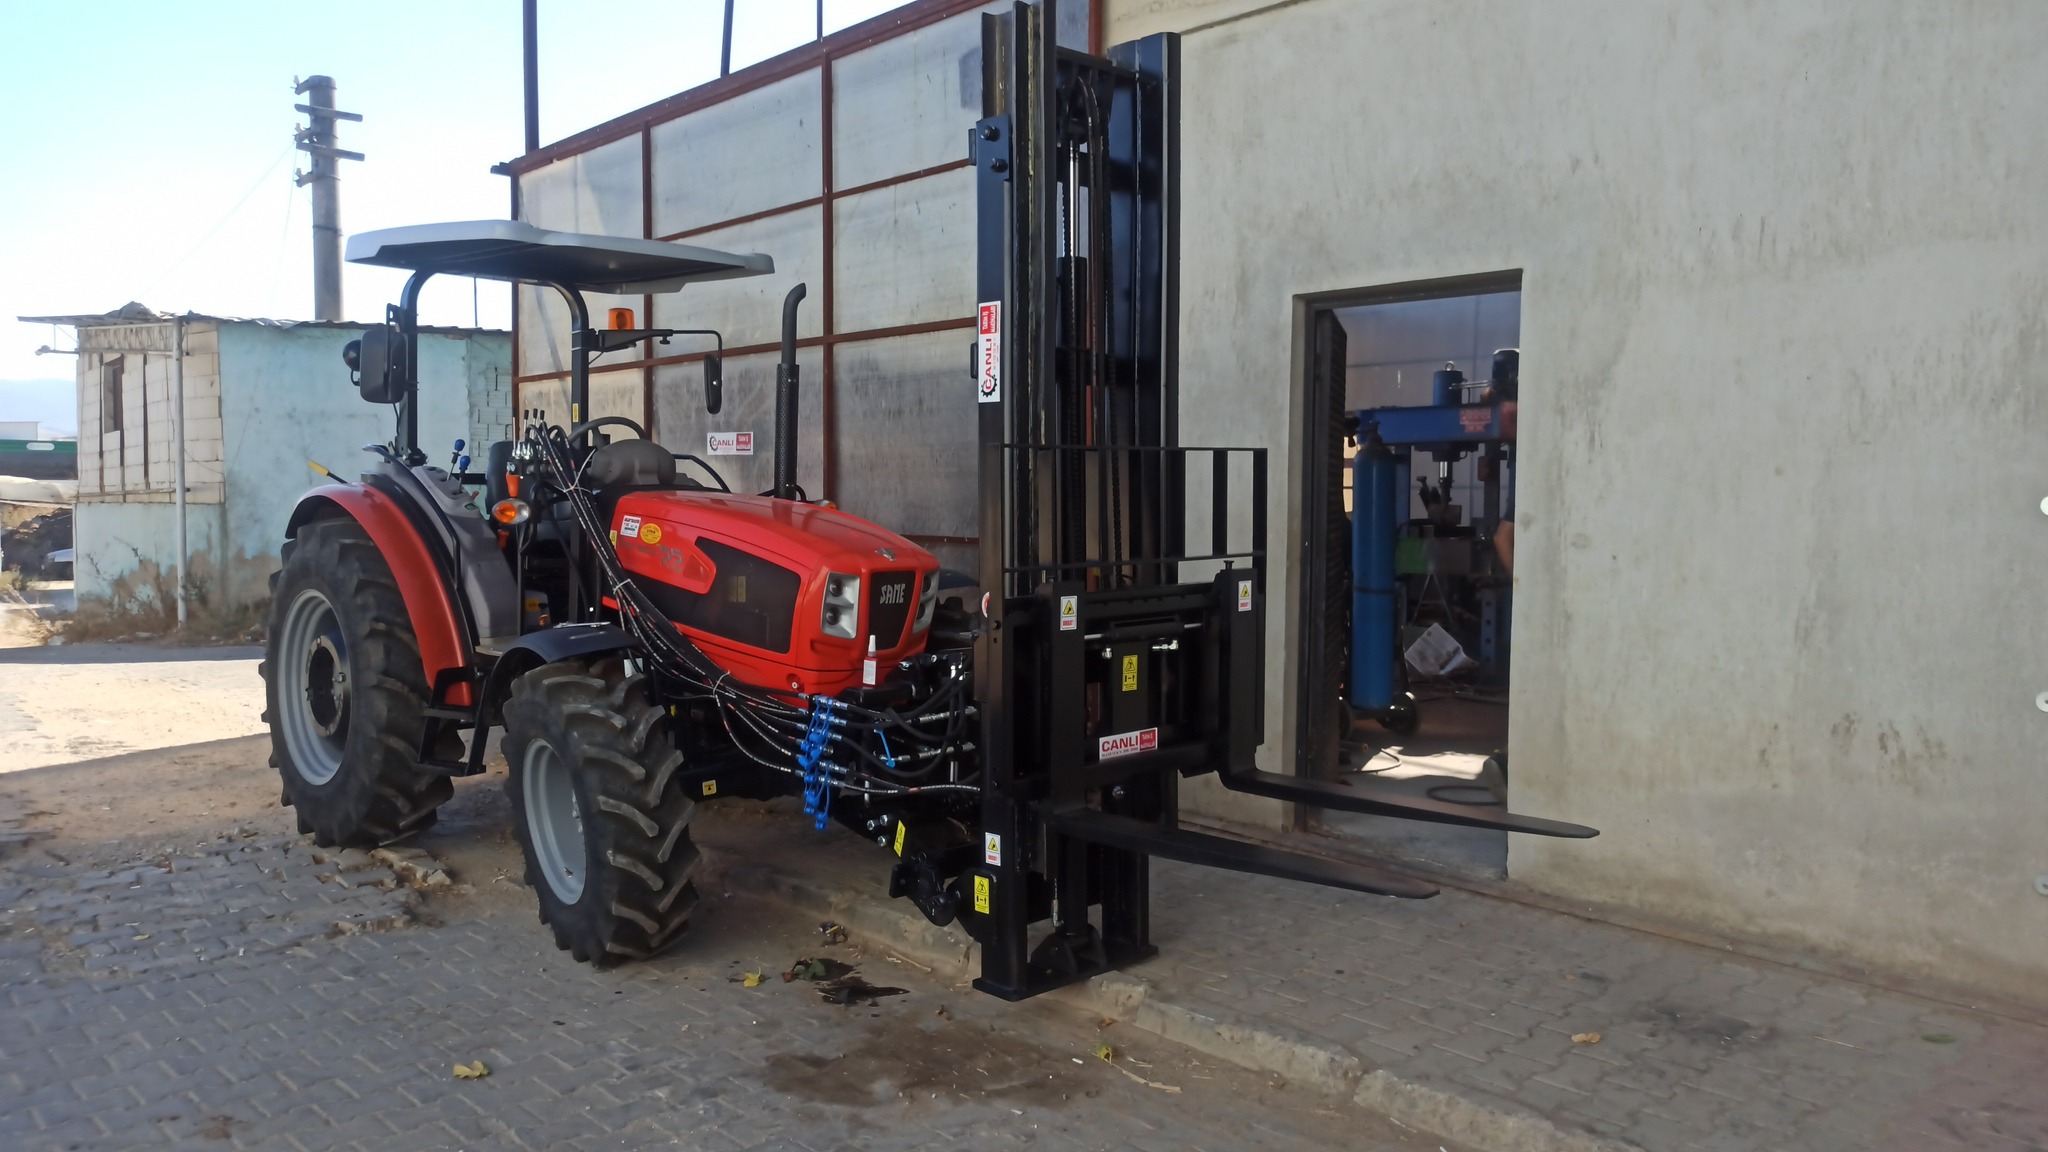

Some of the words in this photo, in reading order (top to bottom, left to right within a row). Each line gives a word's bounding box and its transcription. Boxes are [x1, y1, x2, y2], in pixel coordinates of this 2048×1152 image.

[712, 439, 734, 447] CANLI
[880, 583, 906, 604] SAME
[1101, 735, 1139, 753] CANLI
